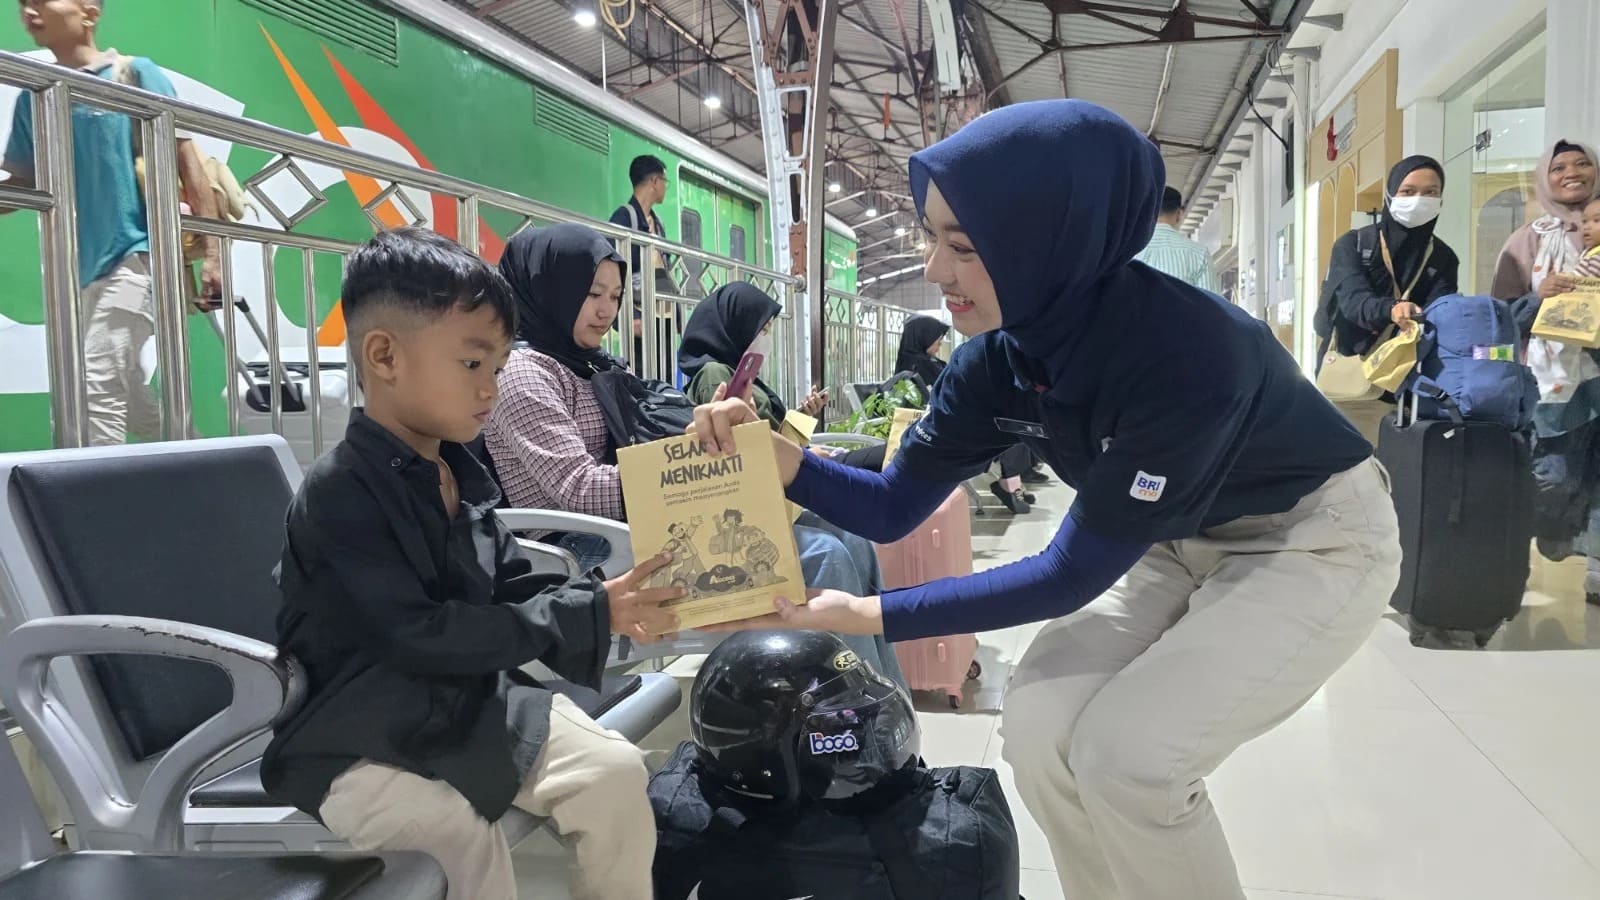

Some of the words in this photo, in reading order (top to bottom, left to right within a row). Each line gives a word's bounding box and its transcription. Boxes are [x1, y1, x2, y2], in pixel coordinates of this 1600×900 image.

[664, 440, 706, 463] SELAM
[661, 454, 743, 488] MENIKMATI
[1137, 477, 1160, 491] BRI
